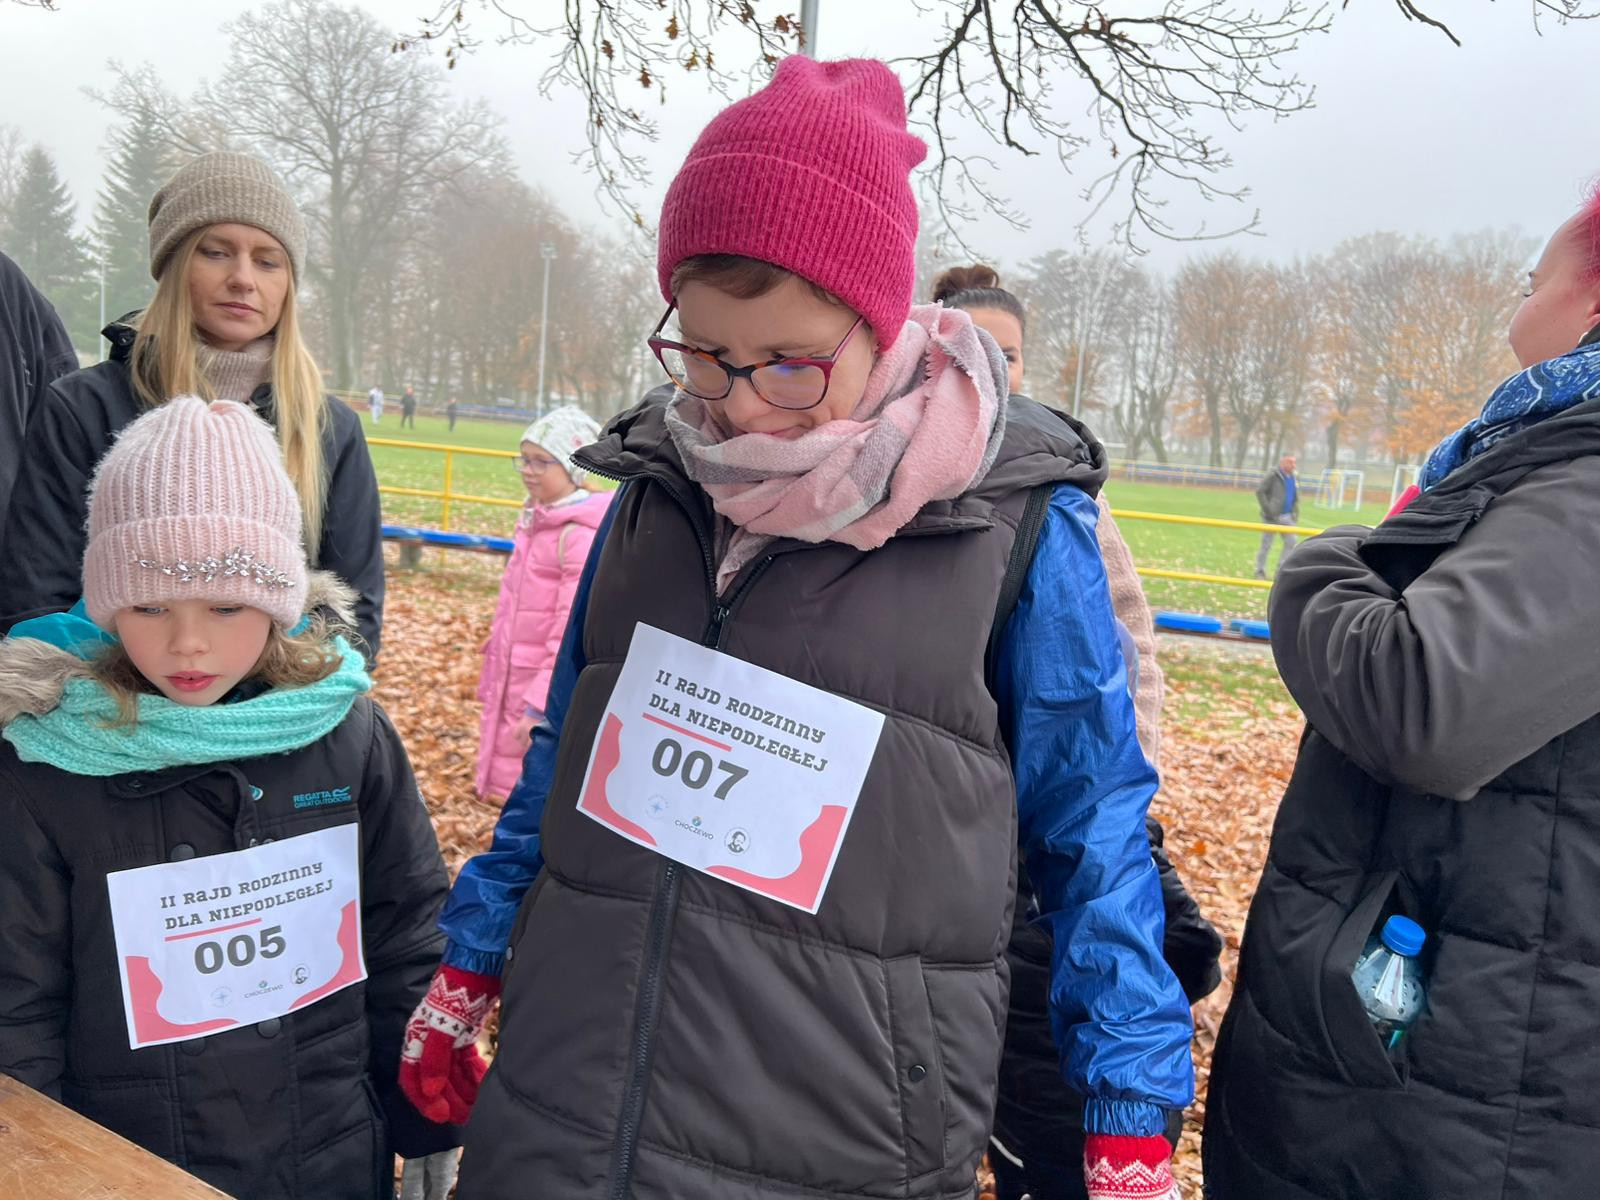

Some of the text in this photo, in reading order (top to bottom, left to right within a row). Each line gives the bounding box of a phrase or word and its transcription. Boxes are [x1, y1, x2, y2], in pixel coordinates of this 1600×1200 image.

[655, 669, 672, 686] II
[648, 693, 829, 772] DLA NIEPODLEGŁEJ
[651, 738, 749, 801] 007
[293, 790, 331, 802] REGATTA
[674, 819, 714, 840] CHOCZEWO
[160, 895, 176, 909] II
[165, 879, 333, 930] DLA NIEPODLEGŁEJ
[194, 925, 286, 975] 005
